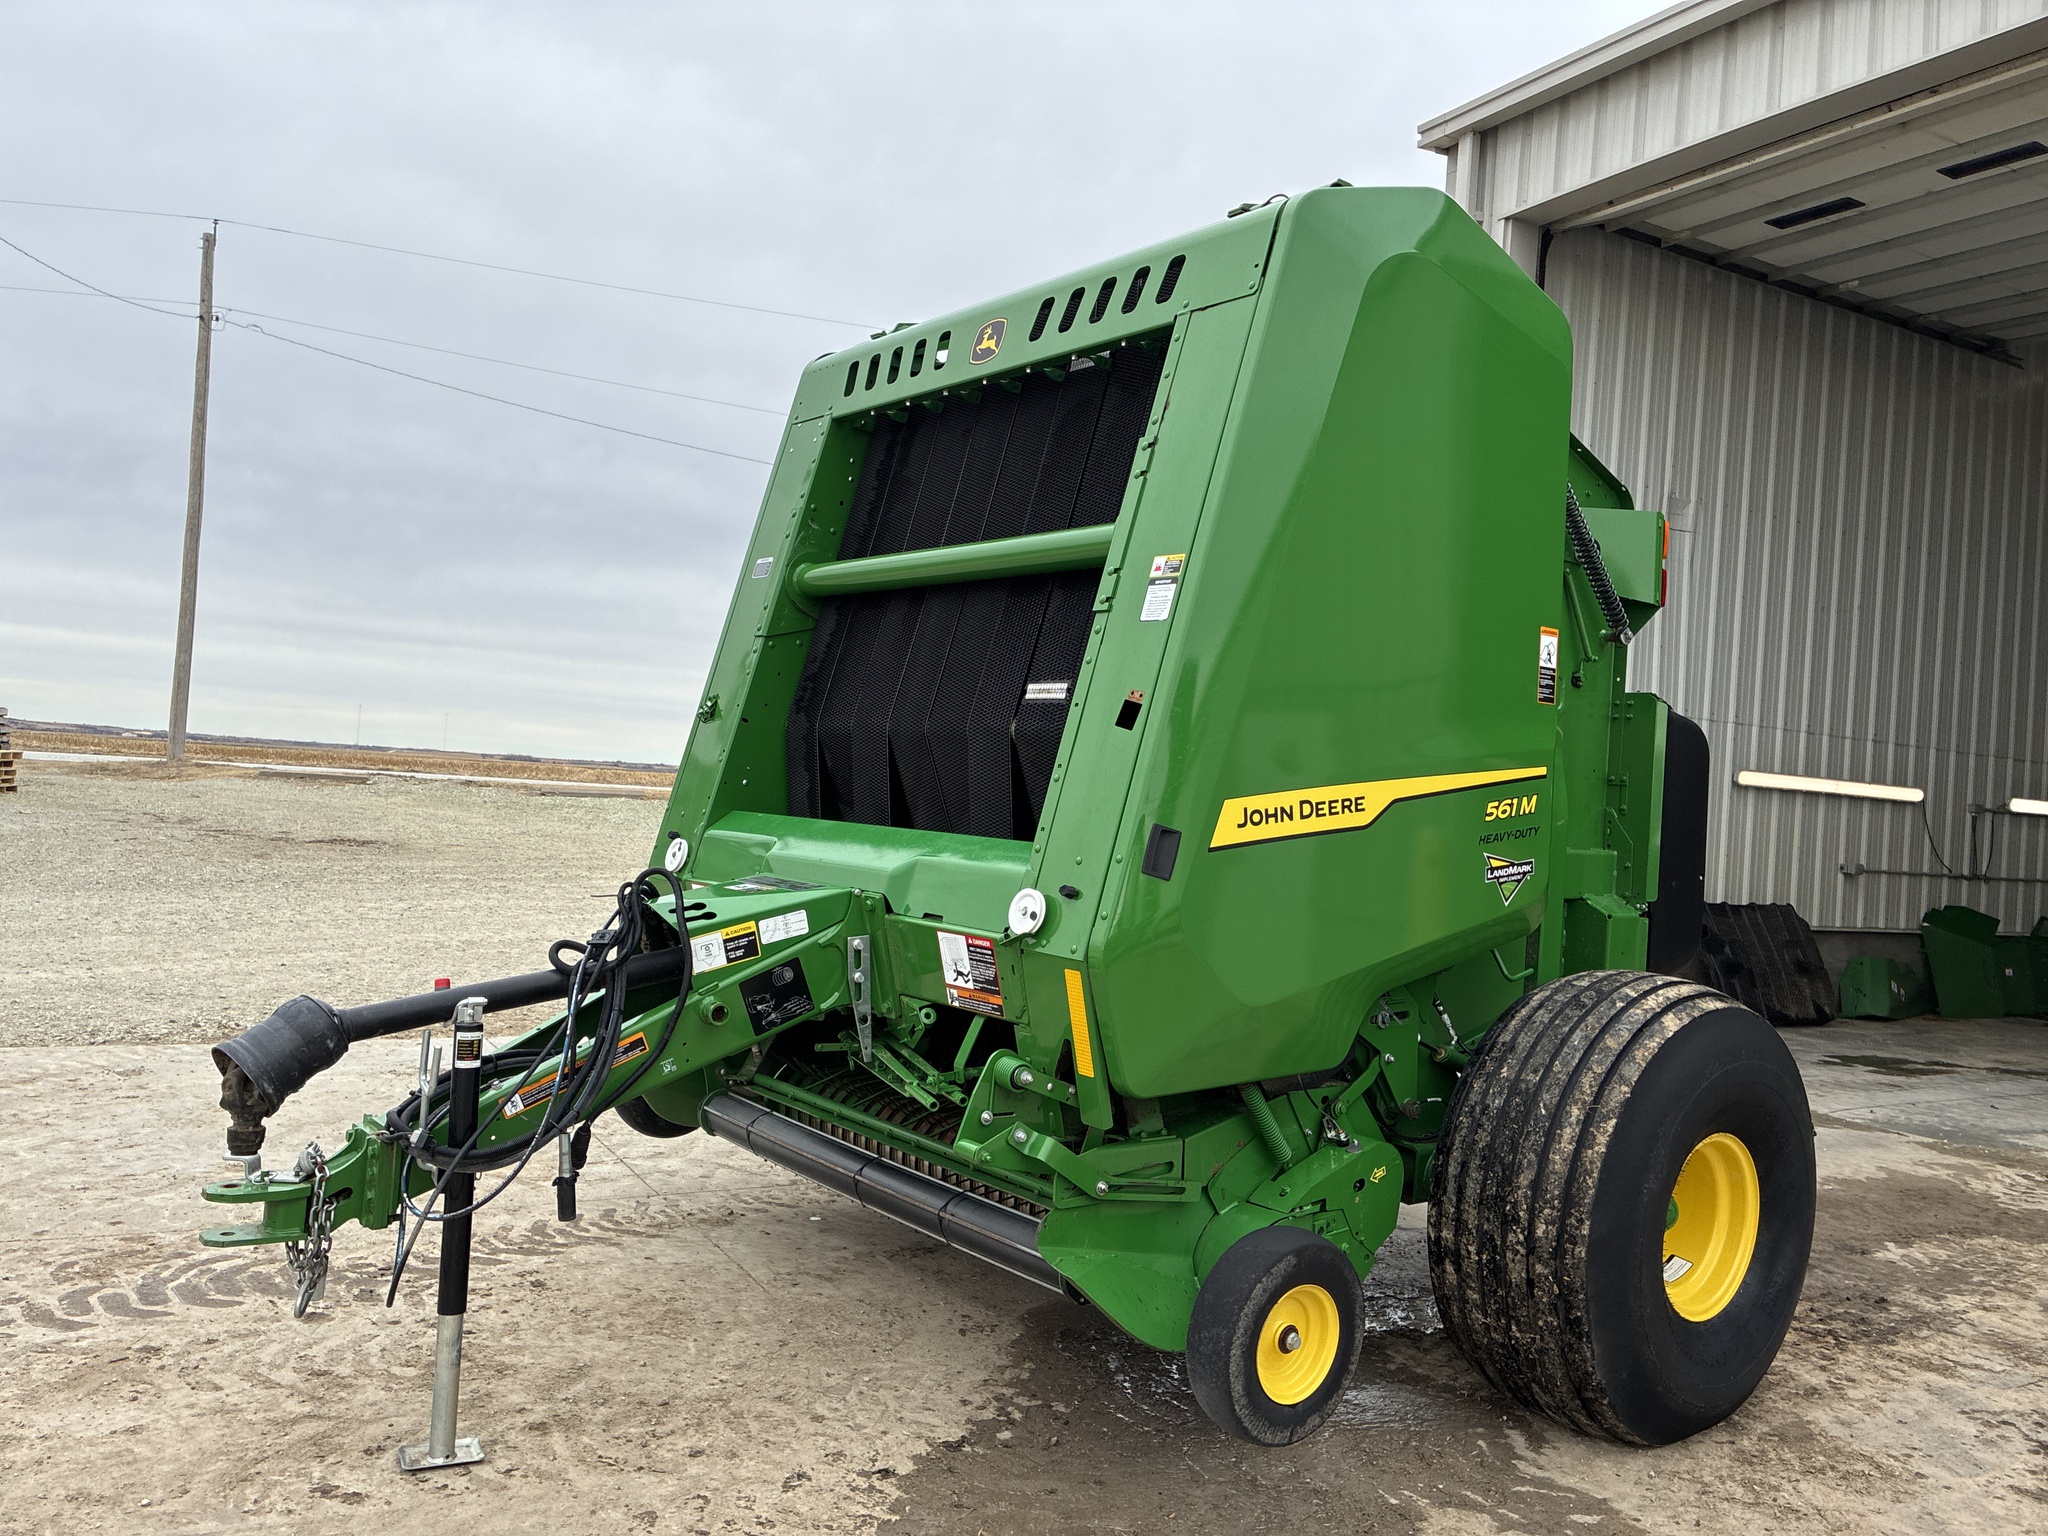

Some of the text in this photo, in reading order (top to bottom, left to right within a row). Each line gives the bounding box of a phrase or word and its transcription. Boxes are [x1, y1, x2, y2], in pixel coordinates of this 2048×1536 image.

[1237, 796, 1366, 829] JOHN DEERE
[1478, 826, 1541, 845] HEAVY-DUTY
[1487, 864, 1532, 879] LANDMARK
[729, 925, 752, 936] CAUTION
[972, 938, 991, 948] DANGER
